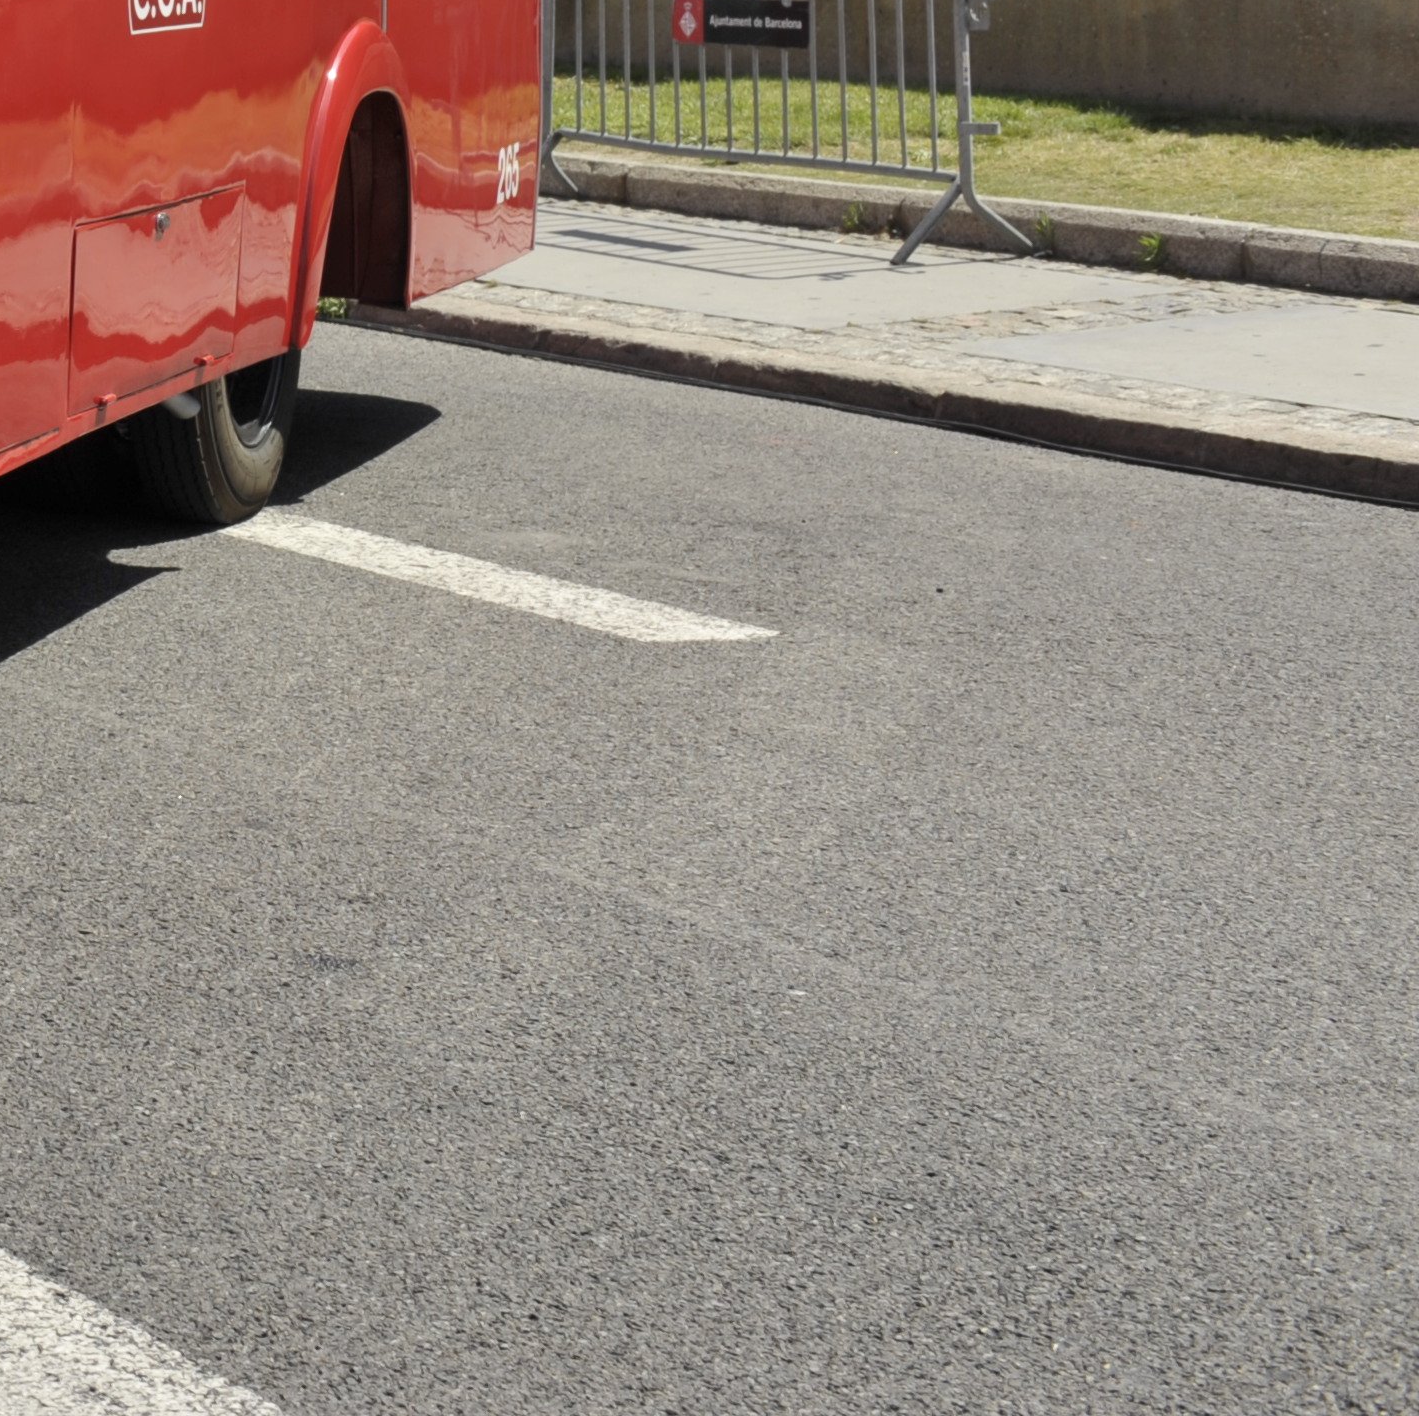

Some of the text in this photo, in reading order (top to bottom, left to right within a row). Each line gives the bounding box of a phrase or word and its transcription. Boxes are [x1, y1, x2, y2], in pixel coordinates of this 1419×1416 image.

[709, 15, 803, 29] Ajuntament de Barcelona
[496, 141, 520, 204] 265
